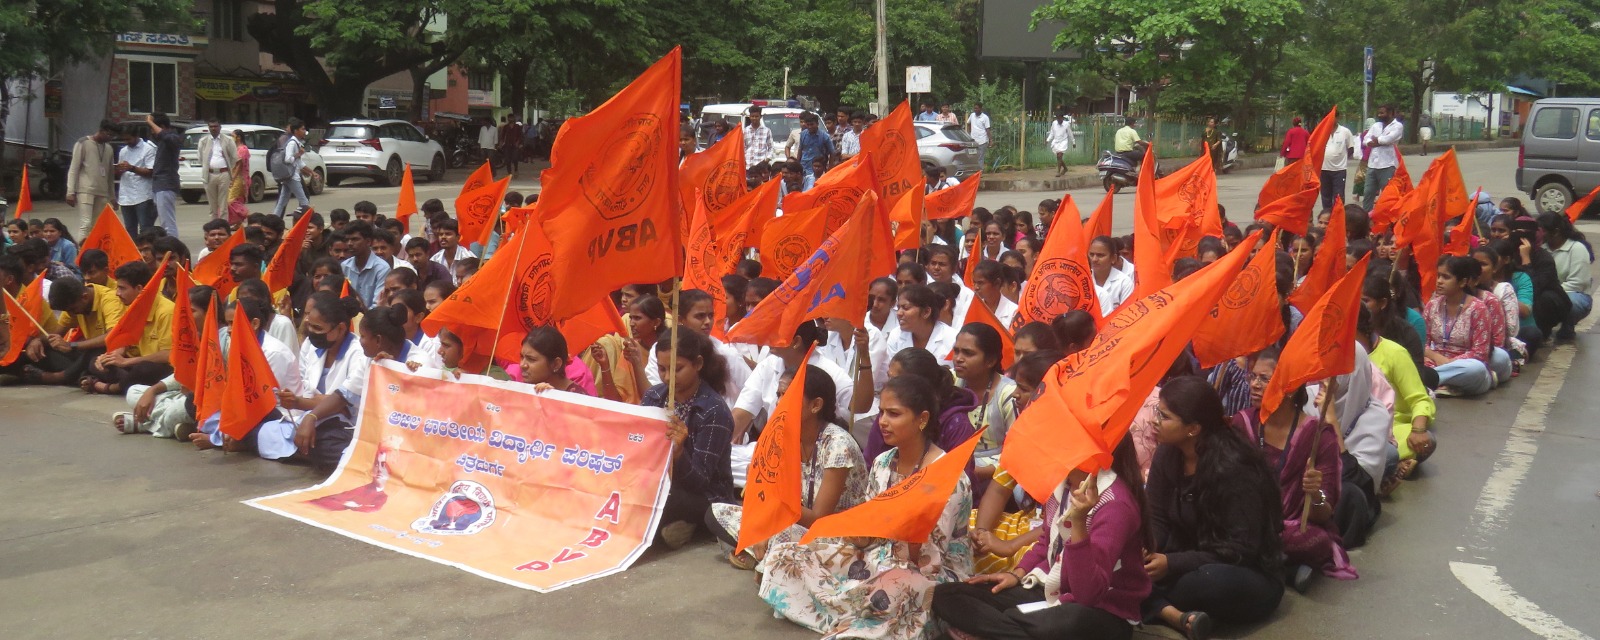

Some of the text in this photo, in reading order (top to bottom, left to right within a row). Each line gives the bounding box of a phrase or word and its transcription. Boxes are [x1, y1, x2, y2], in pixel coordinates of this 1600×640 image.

[145, 33, 190, 45] ಸಮಿತಿ
[1060, 262, 1083, 278] भारतीय
[388, 411, 623, 474] ಅಖಿಲ ಭಾರತೀಯ ವಿದ್ಯಾರ್ಥಿ ಪರಿಷತ್
[456, 454, 505, 476] ಚಿತ್ರದುರ್ಗ
